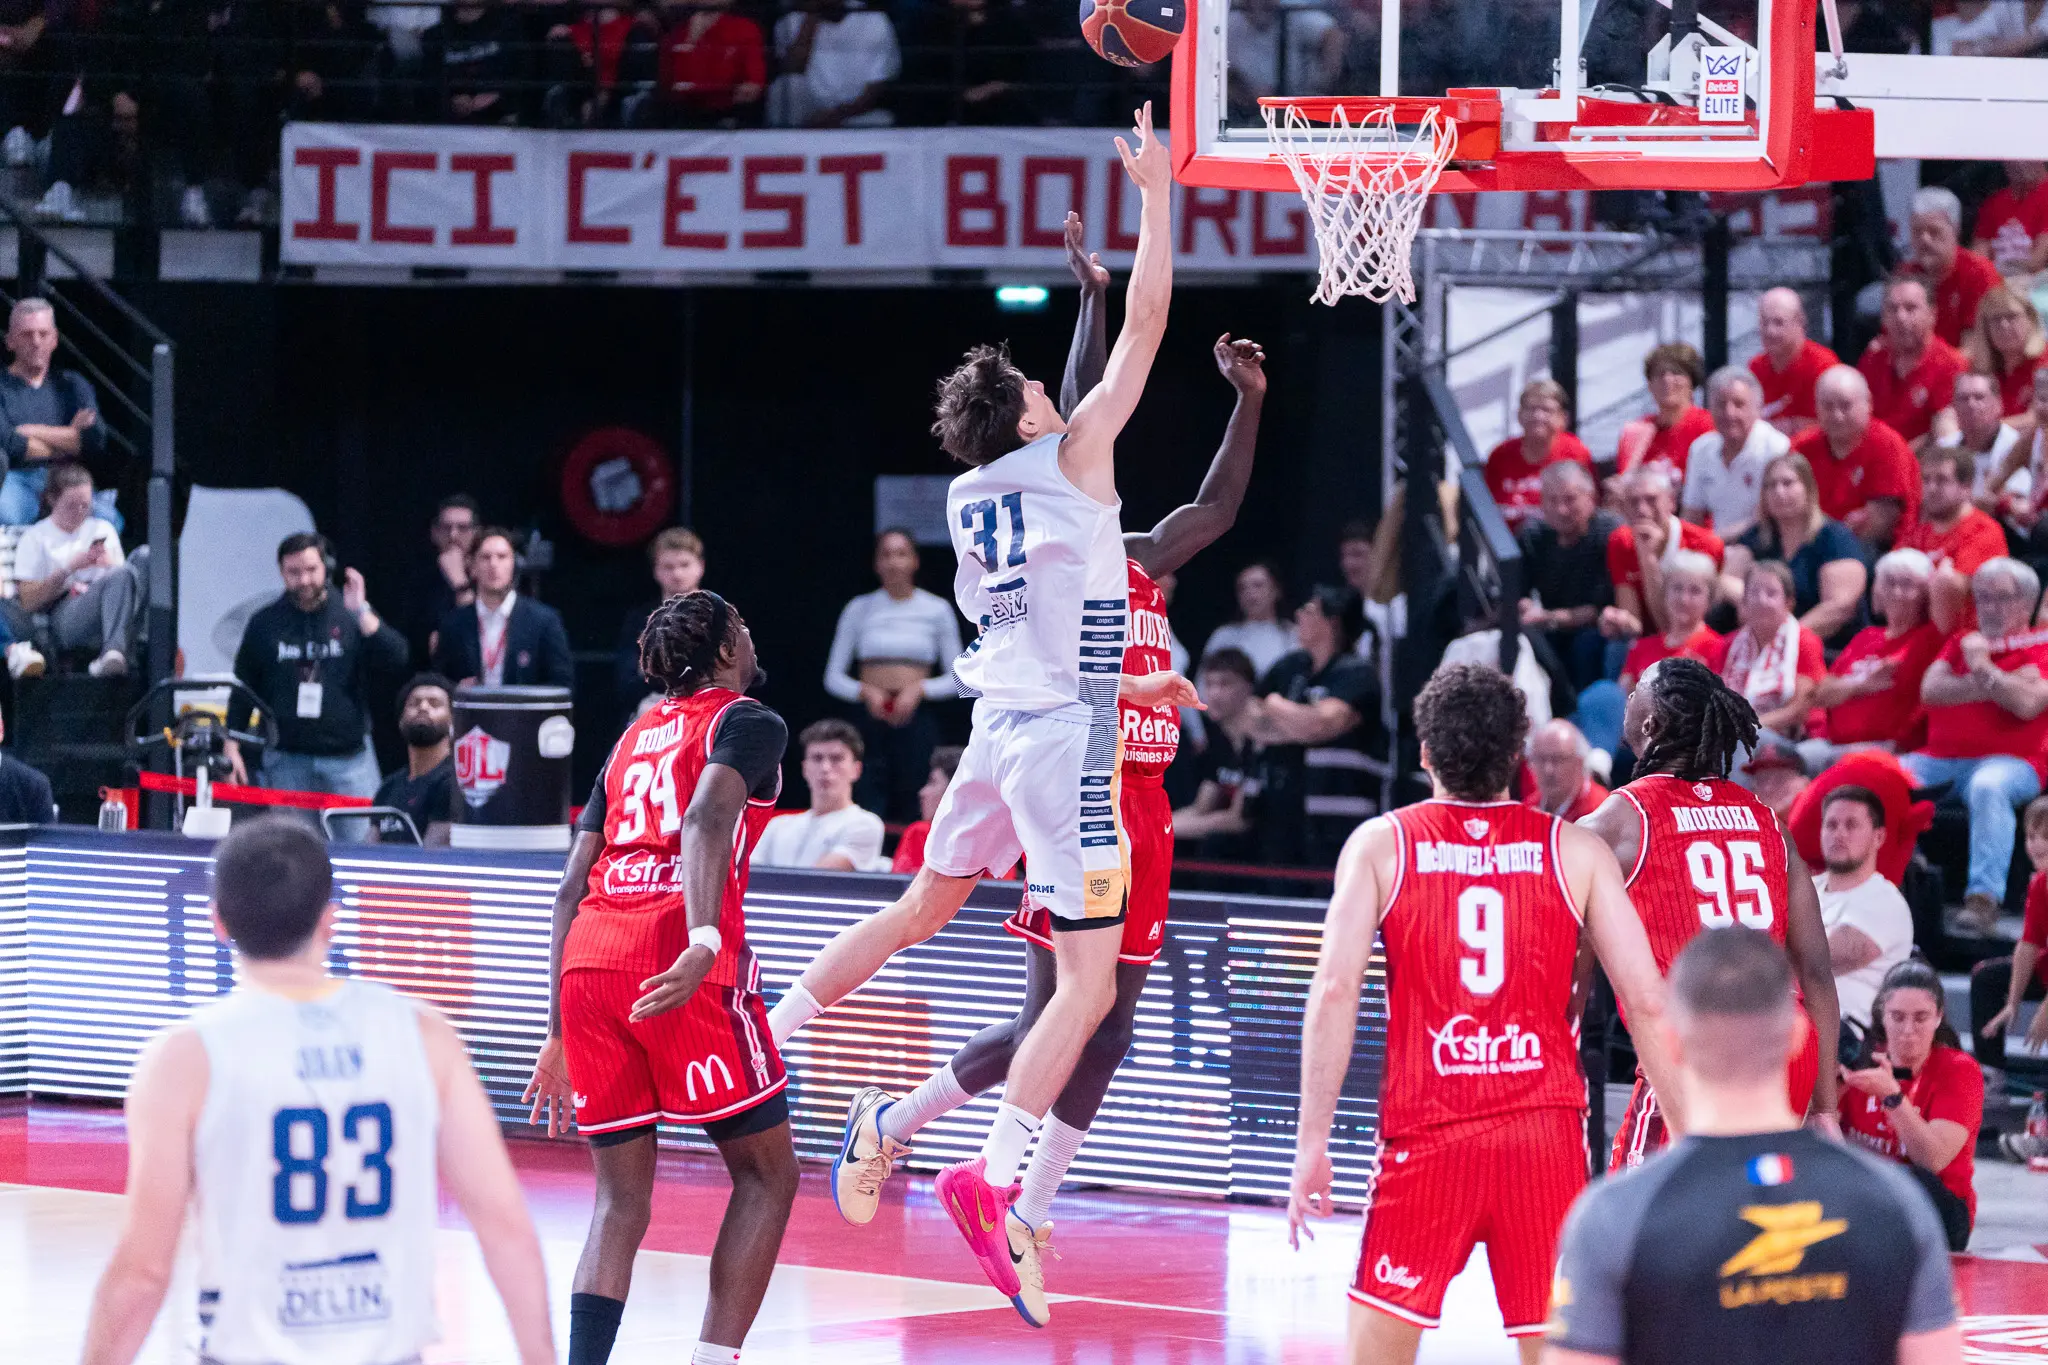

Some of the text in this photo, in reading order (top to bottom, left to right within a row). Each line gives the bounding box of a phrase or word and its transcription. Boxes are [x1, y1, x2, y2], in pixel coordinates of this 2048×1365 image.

[1705, 97, 1738, 114] ÉLITE
[293, 147, 517, 246] ICI
[567, 151, 886, 249] C'EST
[960, 491, 1027, 573] 31
[613, 746, 682, 846] 34
[1125, 747, 1162, 764] uisines
[1415, 840, 1544, 877] McDOWELL-WHITE
[1670, 805, 1760, 833] MOKOKA
[1685, 841, 1774, 930] 95
[1457, 886, 1505, 995] 9
[1426, 1013, 1541, 1077] Astr'in
[272, 1102, 393, 1227] 83
